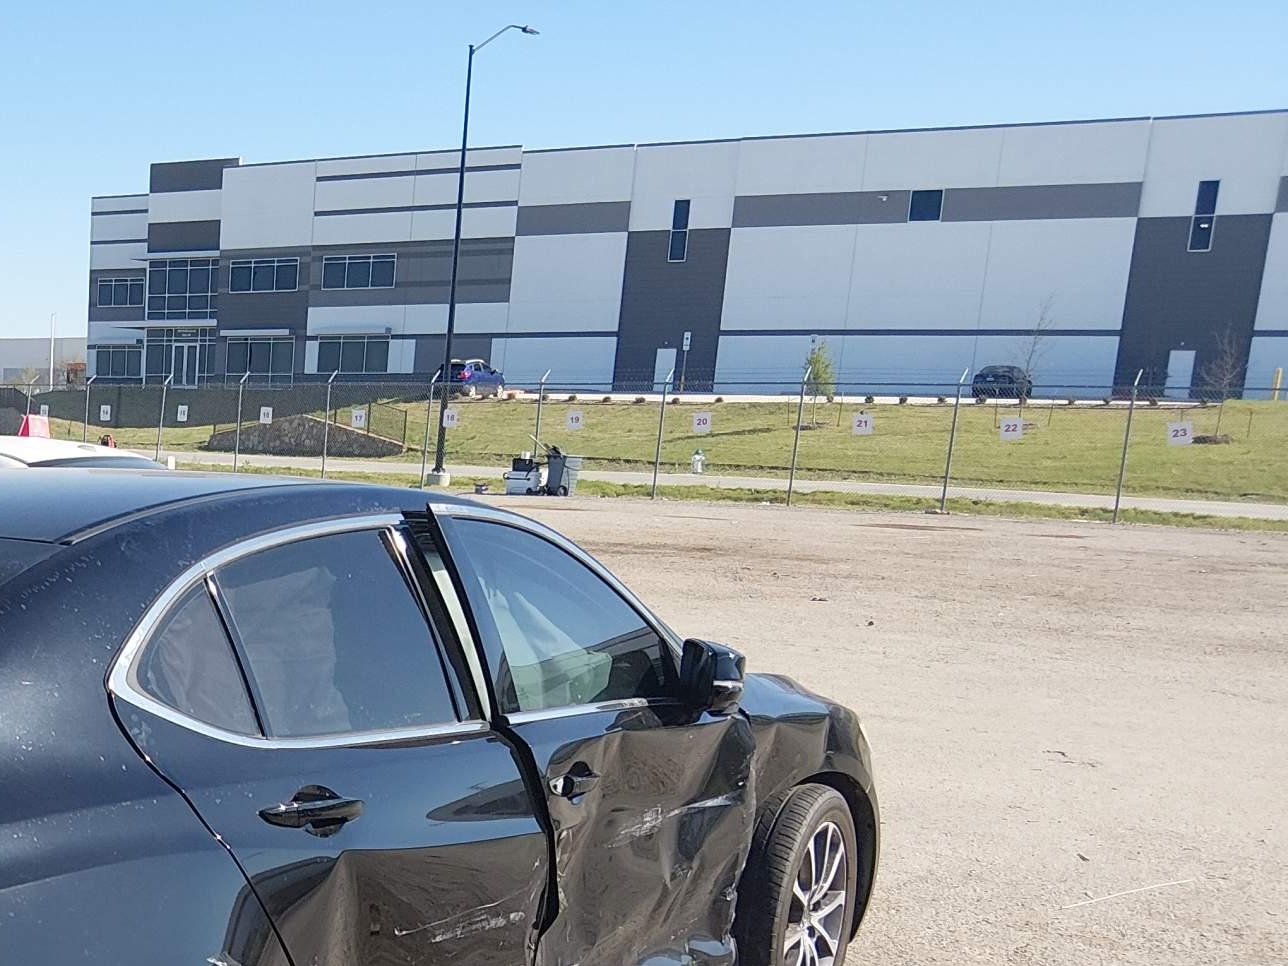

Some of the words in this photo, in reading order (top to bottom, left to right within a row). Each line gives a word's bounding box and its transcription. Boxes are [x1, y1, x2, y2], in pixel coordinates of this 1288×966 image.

[570, 416, 580, 424] 19
[696, 417, 708, 426] 20
[856, 419, 868, 428] 21
[1004, 423, 1018, 433] 22
[1172, 428, 1188, 438] 23
